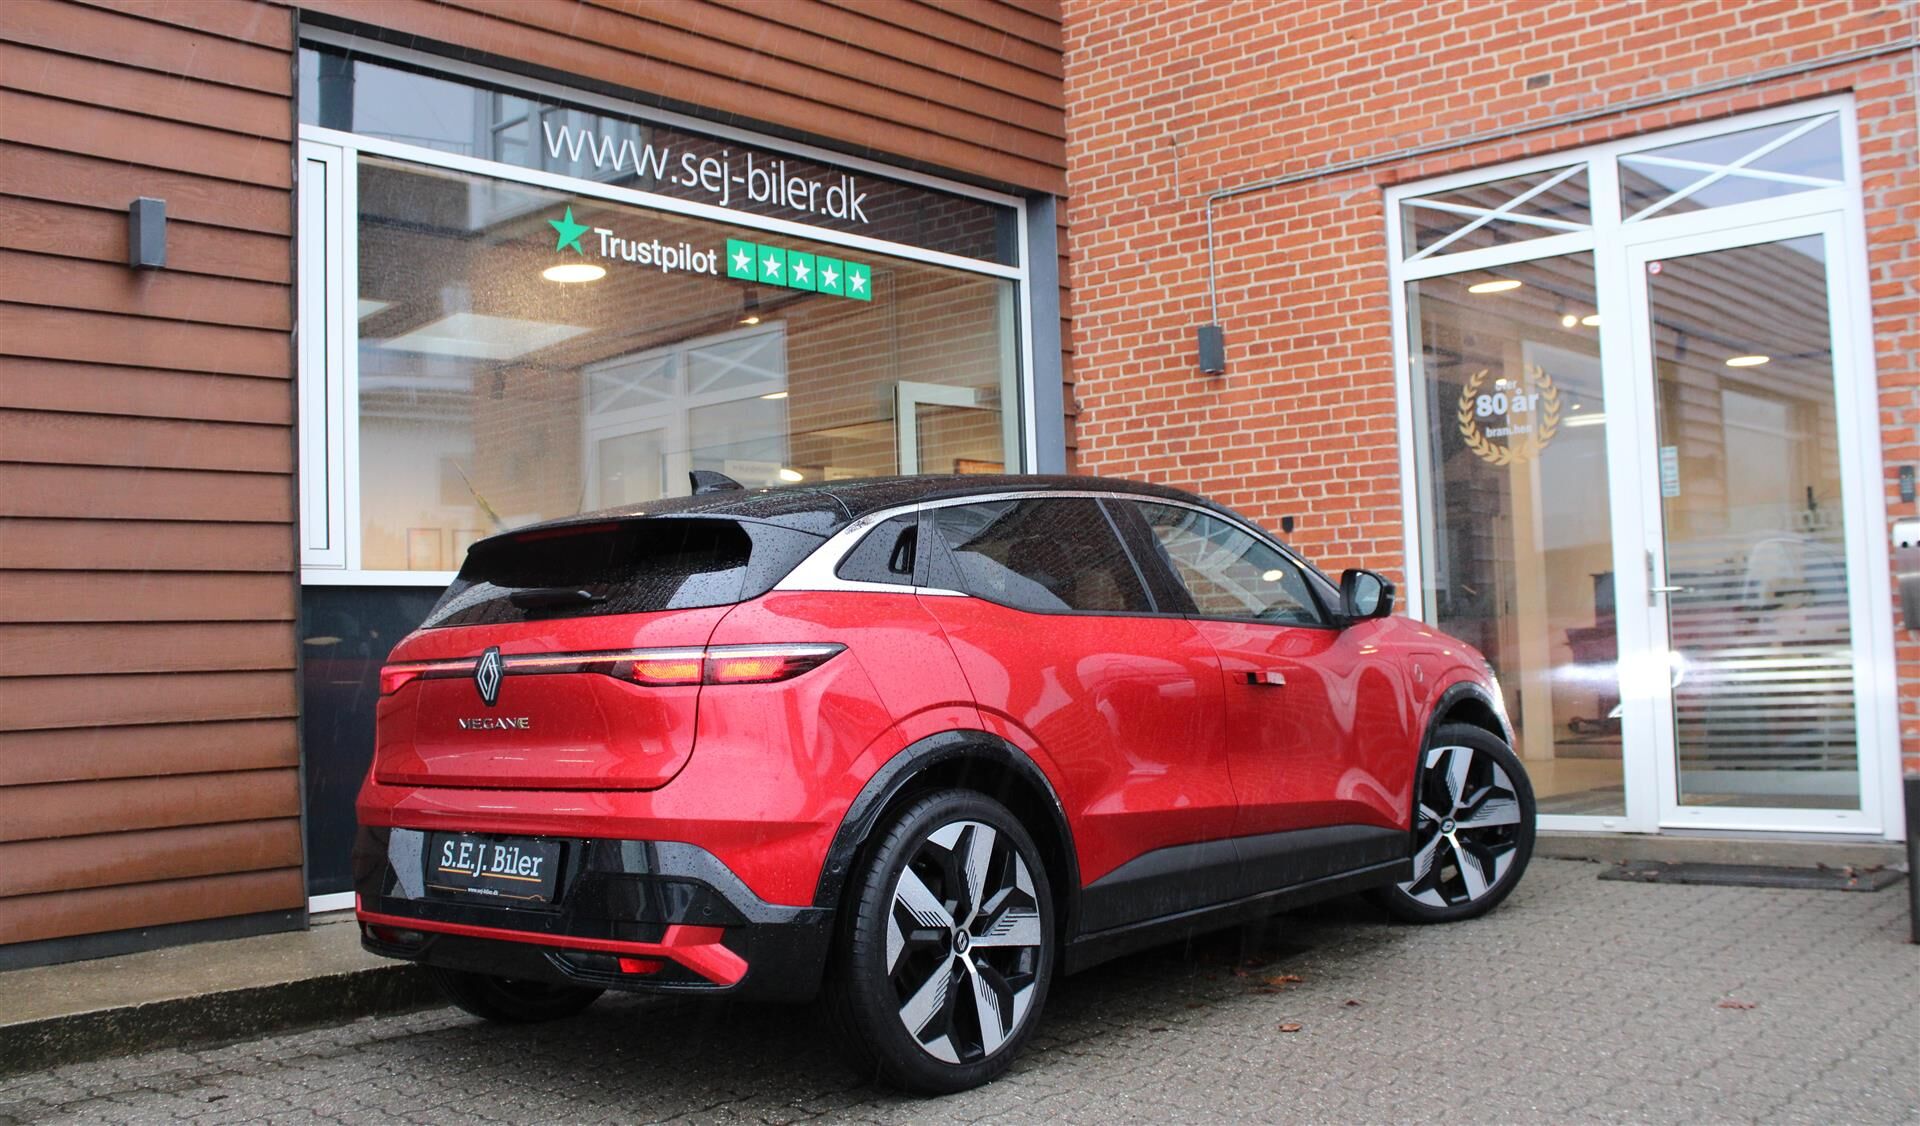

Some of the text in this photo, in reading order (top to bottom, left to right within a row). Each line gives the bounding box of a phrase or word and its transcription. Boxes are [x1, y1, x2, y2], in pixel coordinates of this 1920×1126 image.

[543, 121, 869, 223] www.sej-biler.dk
[594, 227, 718, 276] Trustpilot
[1476, 388, 1539, 417] 80 år
[459, 717, 530, 730] MEGANE
[441, 840, 543, 877] S.E.J. Biler
